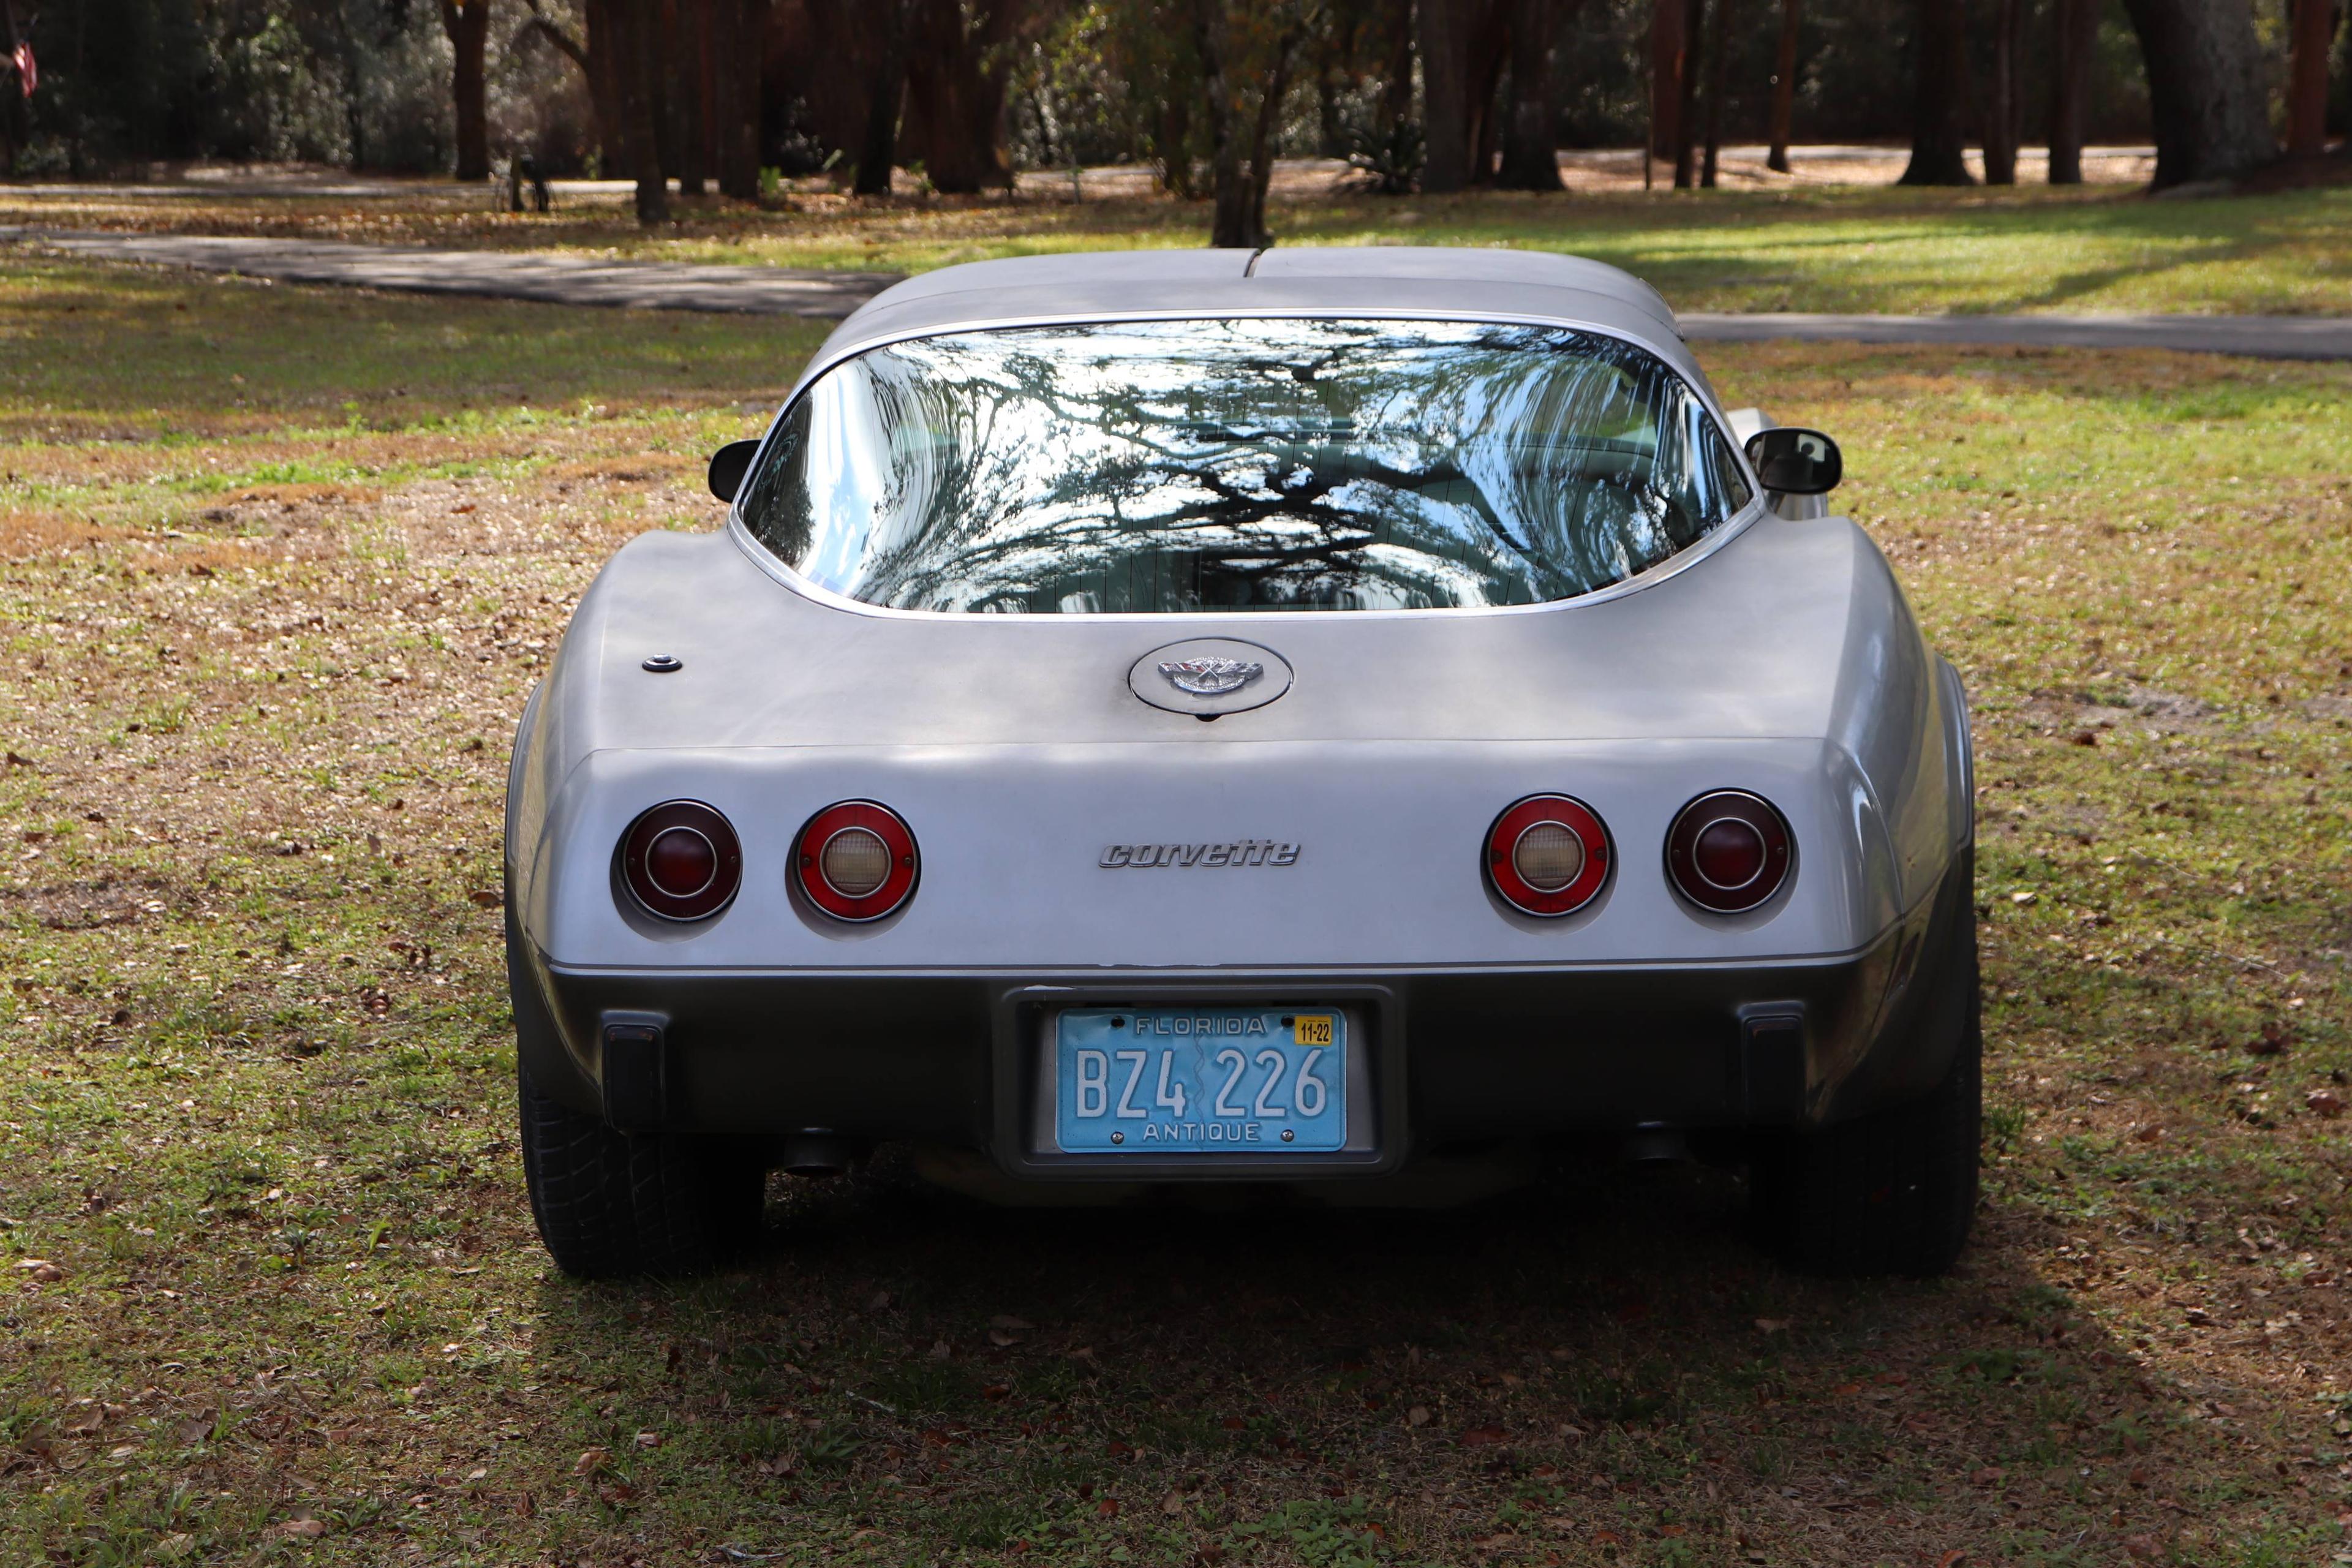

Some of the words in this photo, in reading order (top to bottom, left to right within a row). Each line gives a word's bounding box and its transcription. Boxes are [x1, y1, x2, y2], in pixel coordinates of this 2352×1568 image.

[1099, 839, 1301, 868] corvette
[1136, 1017, 1267, 1035] FLORIDA
[1301, 1023, 1329, 1042] 11-22
[1076, 1050, 1186, 1118] BZ4
[1215, 1049, 1326, 1117] 226
[1142, 1123, 1259, 1142] ANTIQUE
